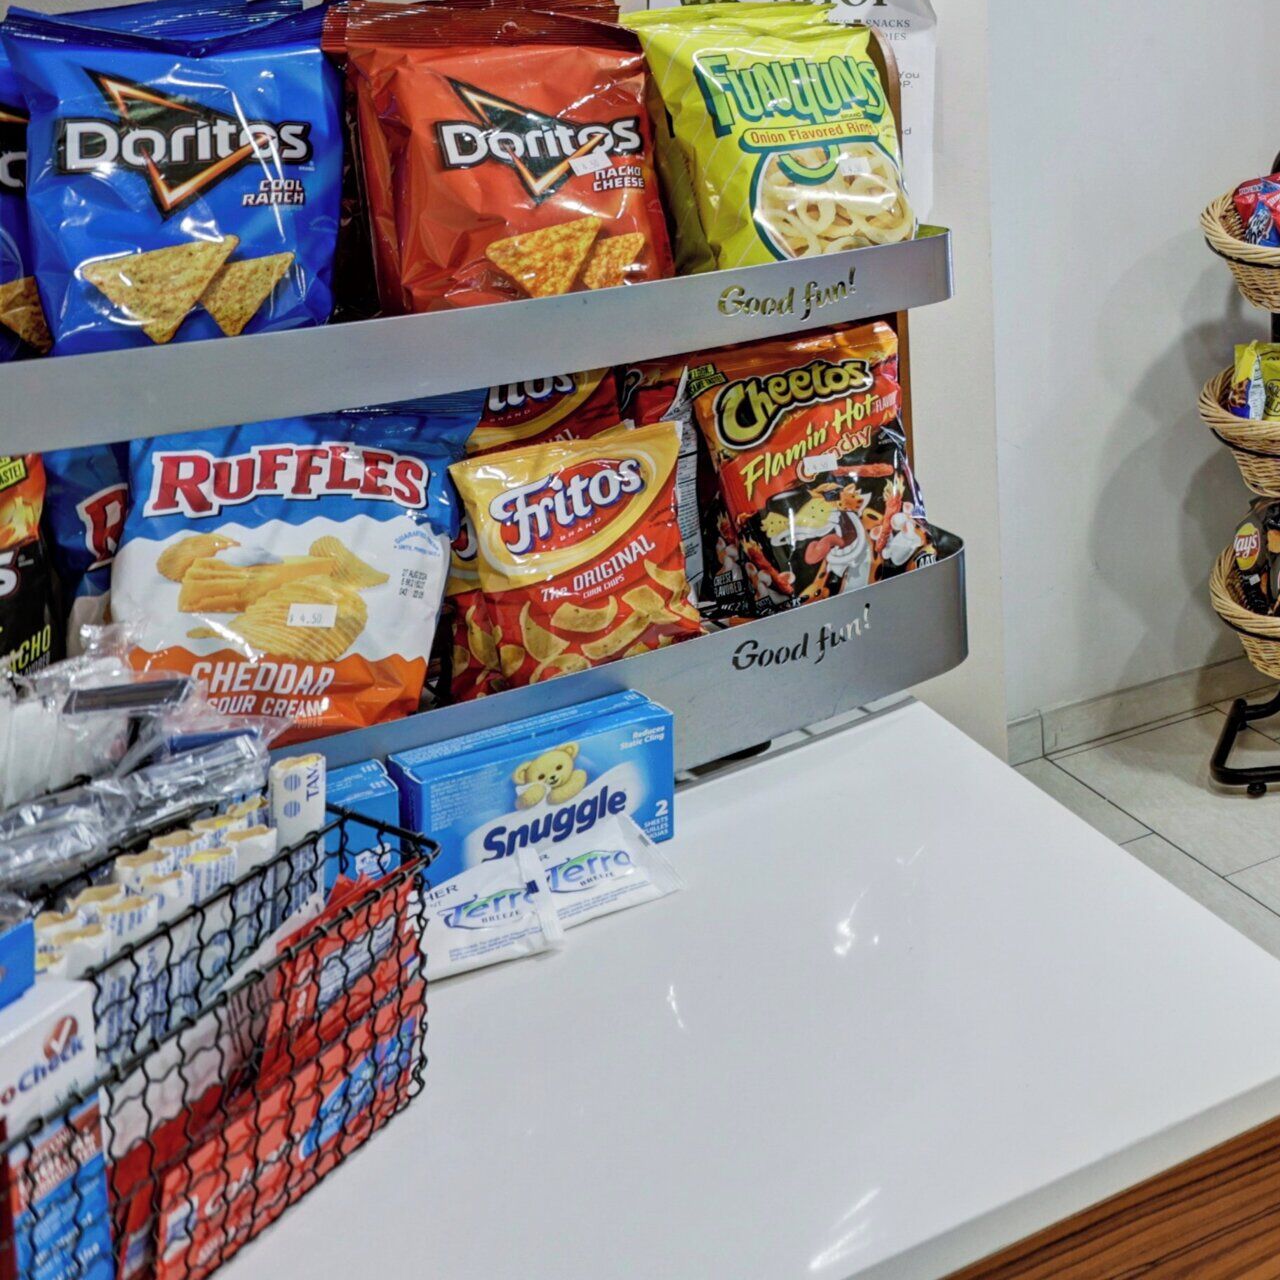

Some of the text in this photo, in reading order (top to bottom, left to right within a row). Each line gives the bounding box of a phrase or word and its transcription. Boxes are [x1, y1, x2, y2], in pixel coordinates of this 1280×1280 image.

[695, 55, 885, 134] FUNYUNS
[66, 121, 309, 171] Doritos
[441, 119, 642, 166] Doritos
[750, 124, 843, 145] Onion Flavored
[258, 179, 304, 193] COOL
[592, 177, 645, 192] CHEESE
[595, 166, 642, 180] NACHO
[242, 192, 305, 207] RANCH
[717, 267, 857, 321] Good fun!
[714, 359, 872, 448] Cheetos
[740, 393, 880, 500] Flamin' Hot
[152, 446, 427, 513] RUFFLES
[489, 458, 644, 555] Fritos
[559, 516, 602, 542] BRAND
[572, 534, 657, 592] ORIGINAL
[732, 602, 871, 671] Good fun!
[190, 661, 336, 695] CHEDDAR
[206, 696, 326, 718] SOUR CREAM
[620, 732, 665, 751] Static Cling
[632, 725, 665, 740] Reduces
[481, 784, 628, 865] Snuggle
[655, 798, 669, 818] 2
[17, 1034, 85, 1093] Check
